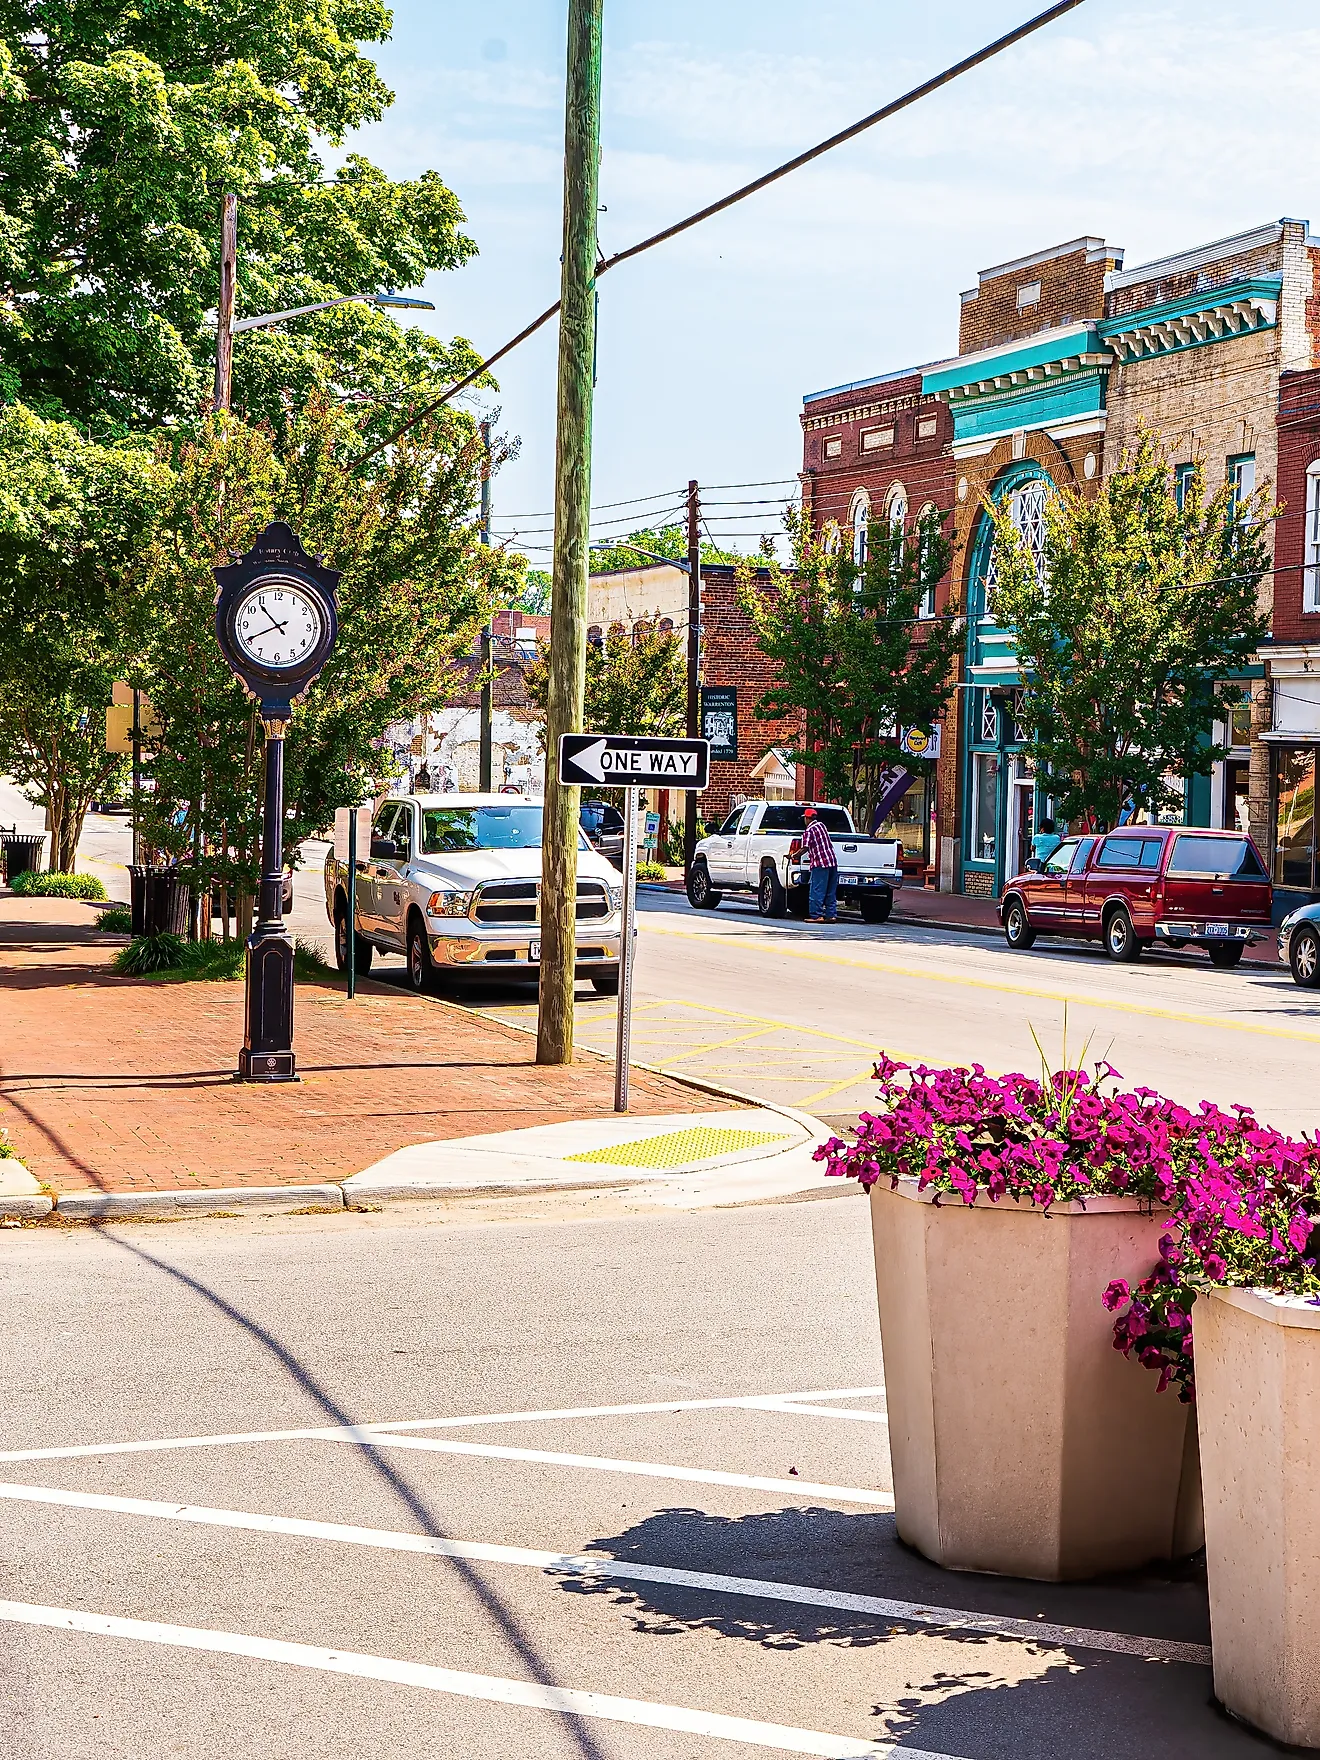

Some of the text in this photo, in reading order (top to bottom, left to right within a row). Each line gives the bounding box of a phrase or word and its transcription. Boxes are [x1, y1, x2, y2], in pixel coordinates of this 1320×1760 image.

[258, 595, 265, 605] 11
[273, 592, 283, 601] 12
[292, 596, 296, 606] 1
[247, 605, 256, 615] 10
[301, 607, 308, 616] 2
[242, 620, 249, 630] 9
[305, 623, 312, 632] 3
[299, 638, 306, 647] 4
[257, 647, 264, 657] 7
[273, 651, 281, 661] 6
[289, 649, 296, 658] 5
[600, 751, 693, 773] ONE WAY
